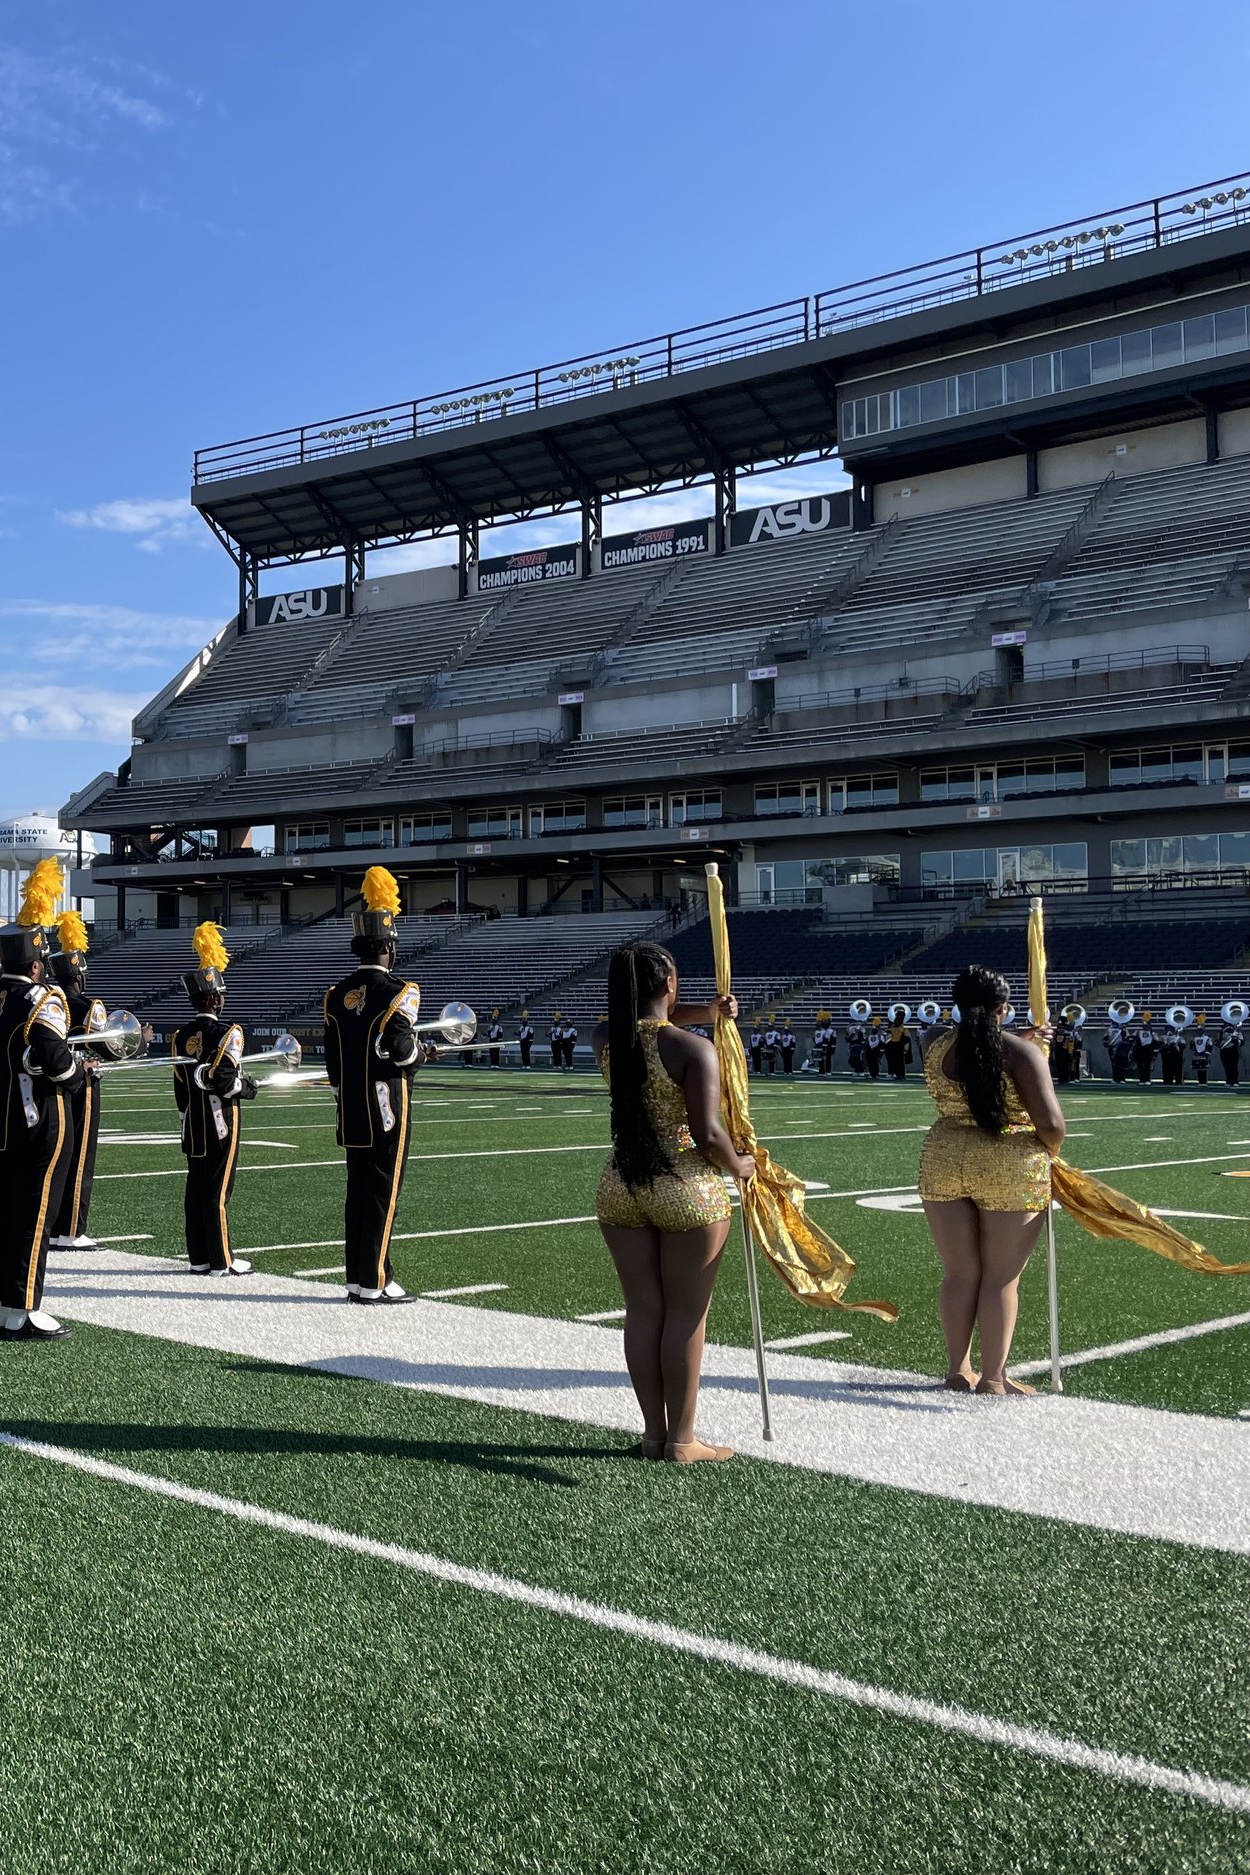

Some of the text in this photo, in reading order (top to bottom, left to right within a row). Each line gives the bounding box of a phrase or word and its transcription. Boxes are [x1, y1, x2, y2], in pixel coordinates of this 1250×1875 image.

[748, 498, 830, 543] ASU
[604, 534, 705, 567] CHAMPIONS 1991
[479, 559, 575, 589] CHAMPIONS 2004
[268, 588, 328, 624] ASU
[252, 1027, 270, 1036] JOIN
[271, 1027, 287, 1036] OUR
